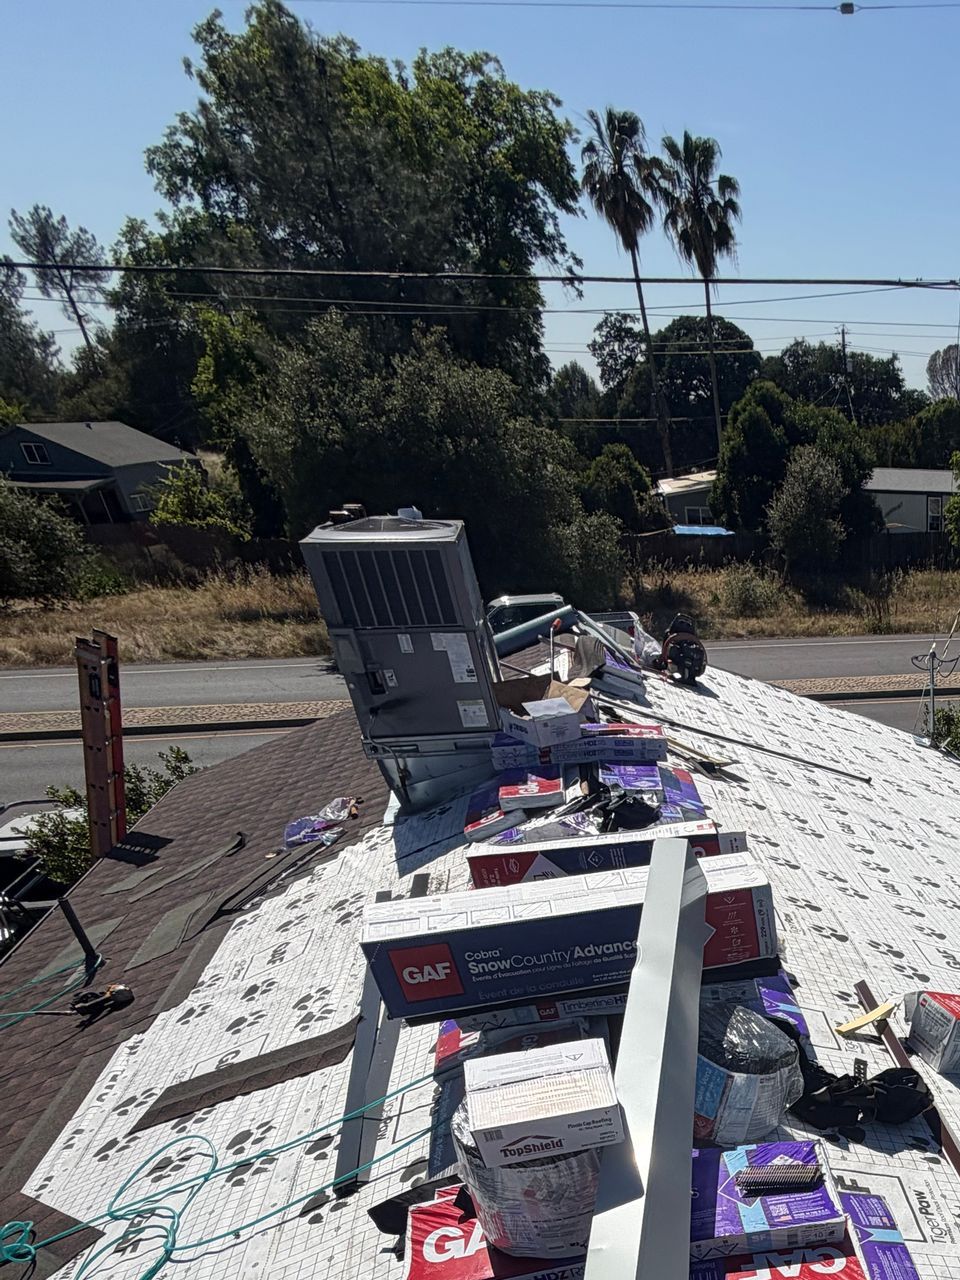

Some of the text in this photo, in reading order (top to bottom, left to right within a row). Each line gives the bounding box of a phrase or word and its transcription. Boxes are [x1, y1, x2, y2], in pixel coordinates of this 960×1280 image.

[465, 950, 501, 961] Cobra
[469, 940, 638, 975] SnowCountry Advance
[402, 962, 451, 985] GAF
[500, 1138, 564, 1158] TopShield
[913, 1189, 946, 1244] TigerPaw
[422, 1223, 488, 1263] GA
